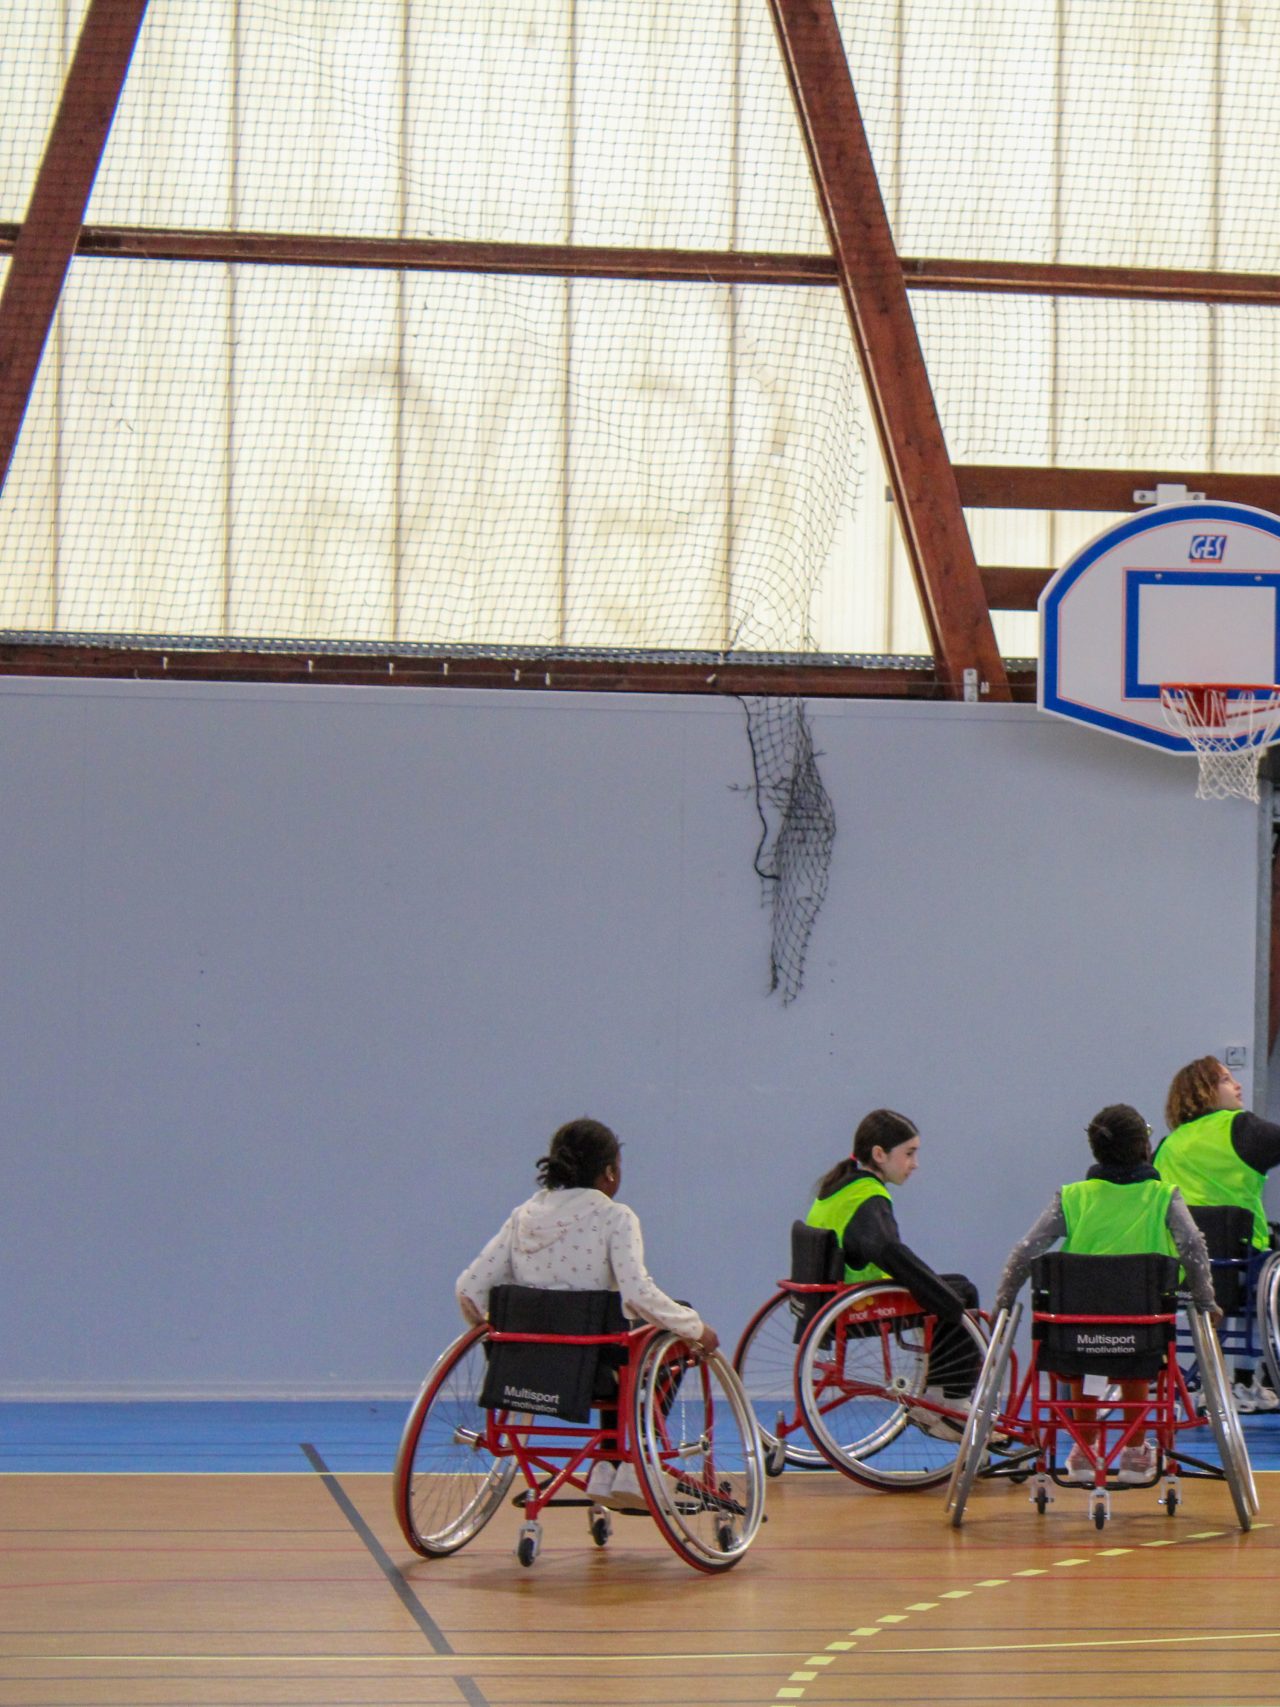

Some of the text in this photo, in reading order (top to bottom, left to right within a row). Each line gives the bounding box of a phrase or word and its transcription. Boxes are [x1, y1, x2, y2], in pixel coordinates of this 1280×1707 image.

[1191, 537, 1225, 559] GES
[1077, 1334, 1136, 1346] Multisport
[1086, 1346, 1136, 1354] motivation
[504, 1385, 560, 1405] Multisport
